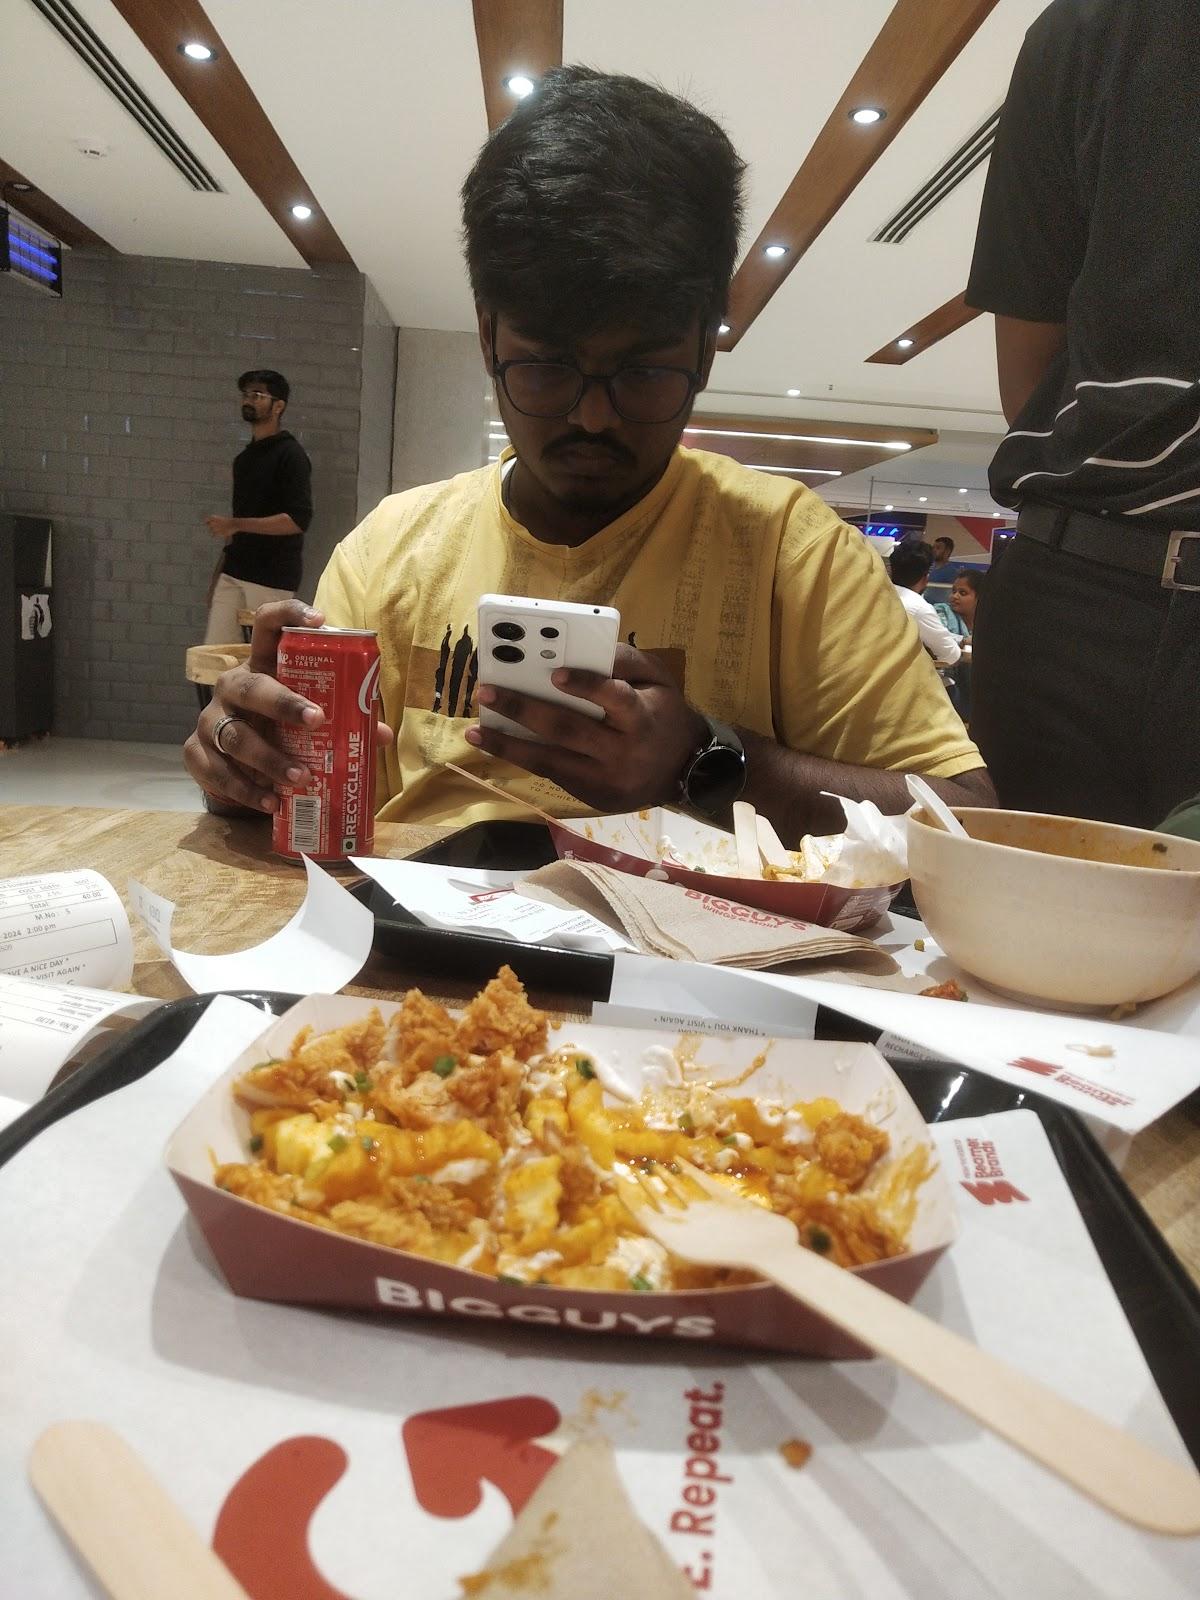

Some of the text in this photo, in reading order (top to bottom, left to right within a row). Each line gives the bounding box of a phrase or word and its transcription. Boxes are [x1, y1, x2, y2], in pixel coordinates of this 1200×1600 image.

[294, 654, 335, 663] ORIGINAL
[295, 660, 319, 668] TASTE
[348, 731, 361, 758] ME
[346, 761, 359, 836] RECYCLE
[684, 889, 807, 931] BIGGUYS
[702, 904, 736, 920] WINGS
[30, 962, 48, 973] NICE
[49, 959, 64, 968] DAY
[36, 965, 81, 981] VISIT AGAIN
[660, 1015, 759, 1036] THANK YOU VISIT AGAIN
[374, 1276, 716, 1337] BIGGUYS
[669, 1380, 734, 1536] Repeat.
